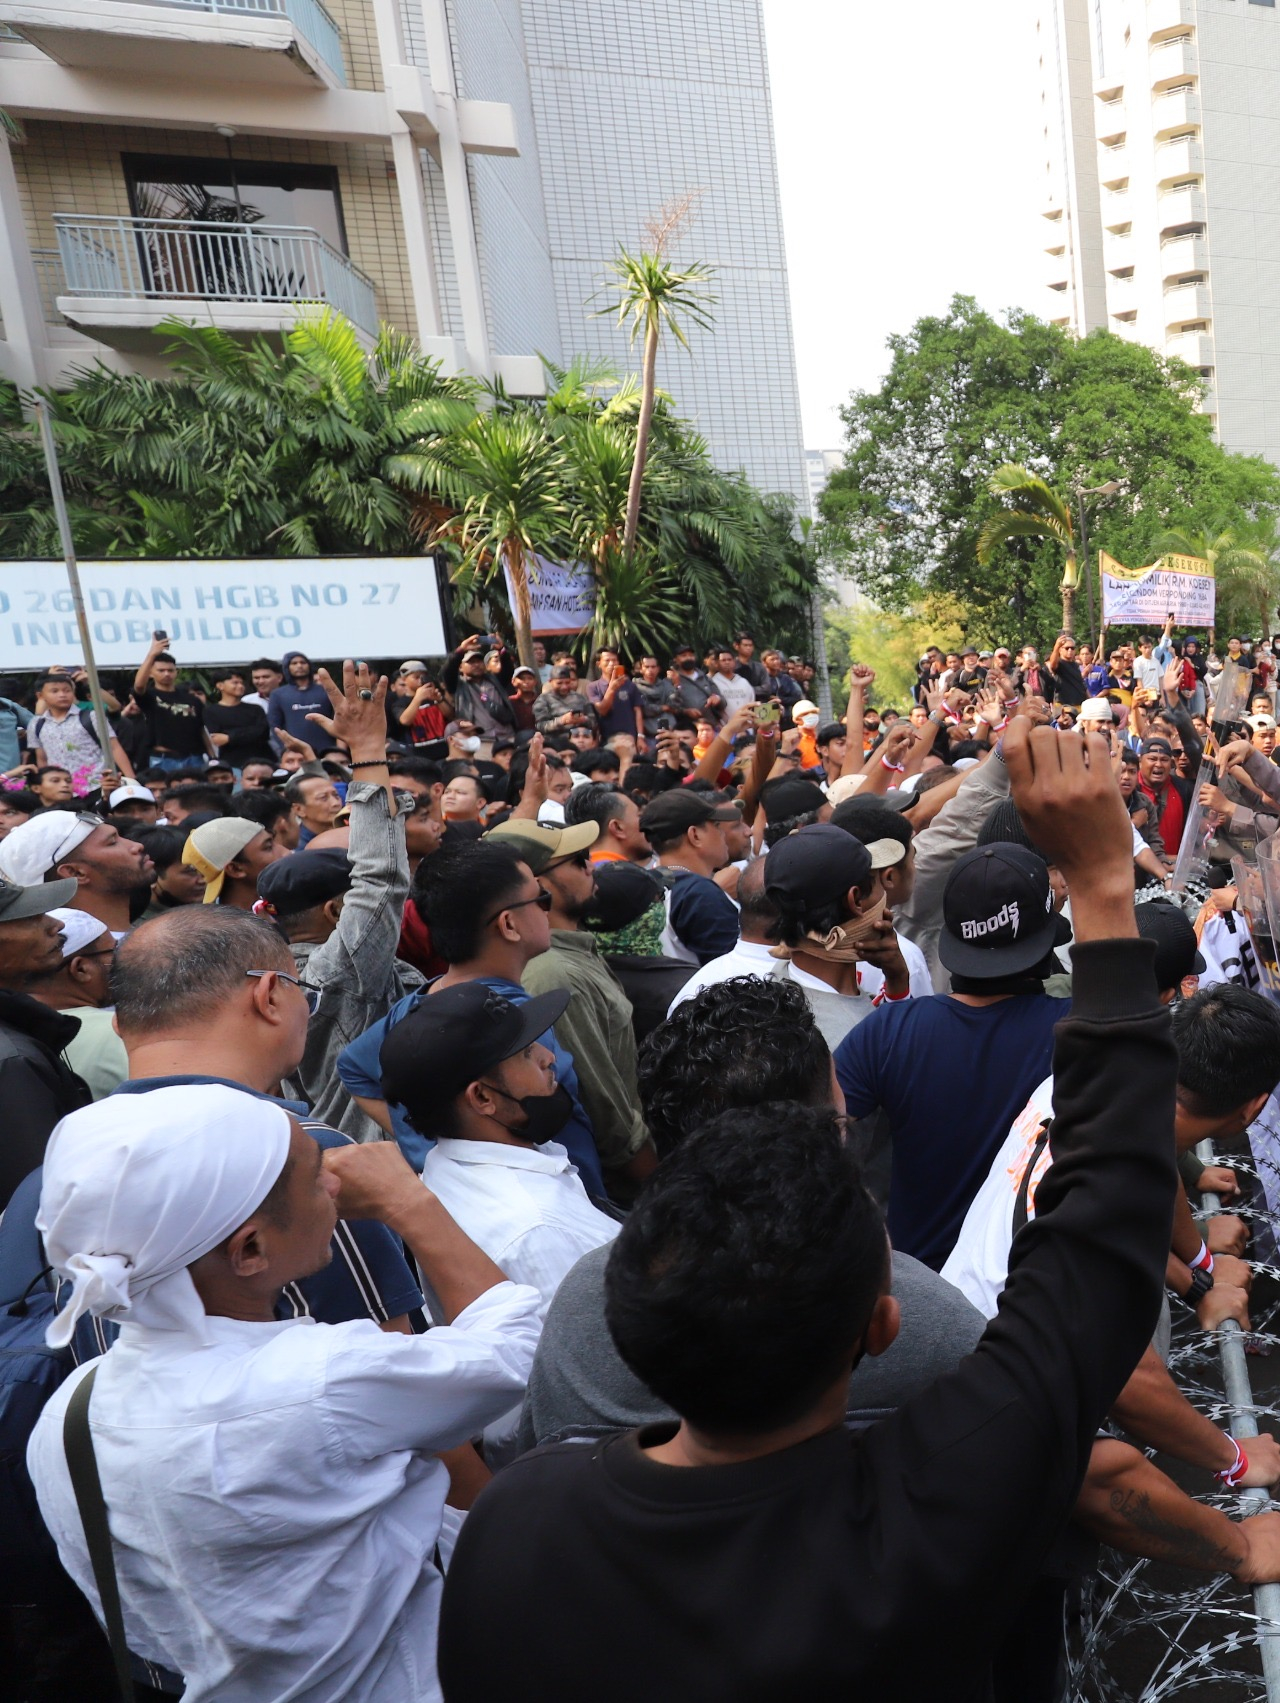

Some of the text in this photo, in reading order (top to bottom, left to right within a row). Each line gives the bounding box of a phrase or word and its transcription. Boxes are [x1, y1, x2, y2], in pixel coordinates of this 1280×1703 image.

[88, 586, 182, 612] DAN
[194, 584, 280, 609] HGB
[290, 583, 348, 607] NO
[359, 582, 401, 605] 27
[12, 615, 302, 646] INDOBUILDCO
[961, 901, 1020, 939] Bloods
